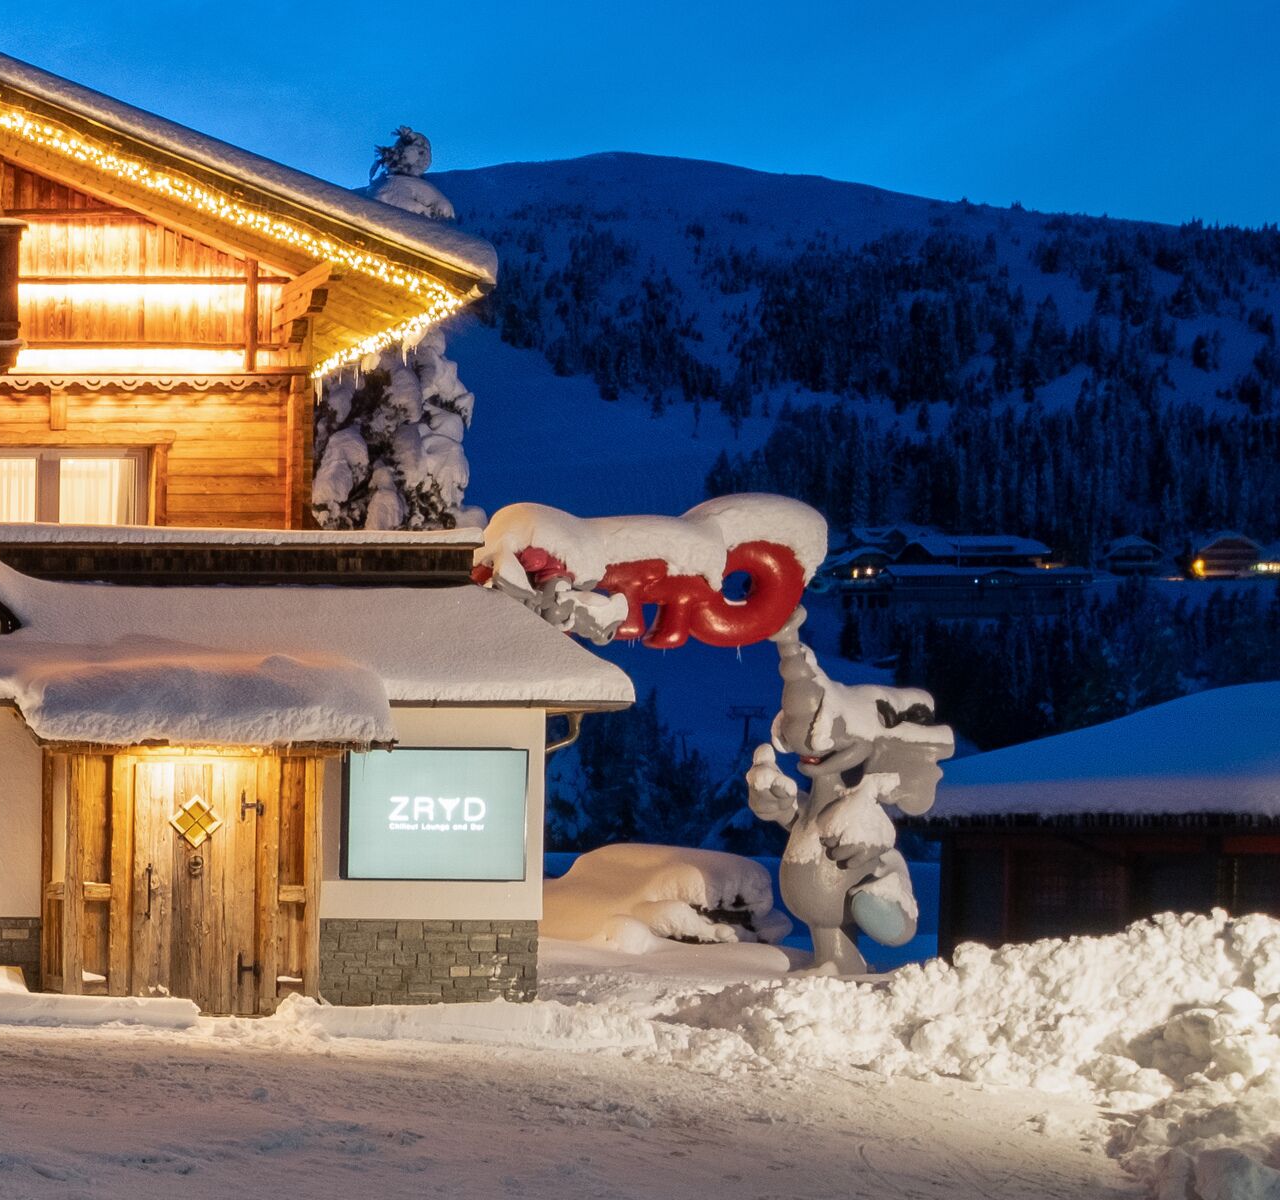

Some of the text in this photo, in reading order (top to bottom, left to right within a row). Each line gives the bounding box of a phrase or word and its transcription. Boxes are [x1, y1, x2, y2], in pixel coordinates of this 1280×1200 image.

[388, 796, 486, 822] ZRYD
[421, 822, 450, 833] Lounge
[452, 822, 468, 831] and
